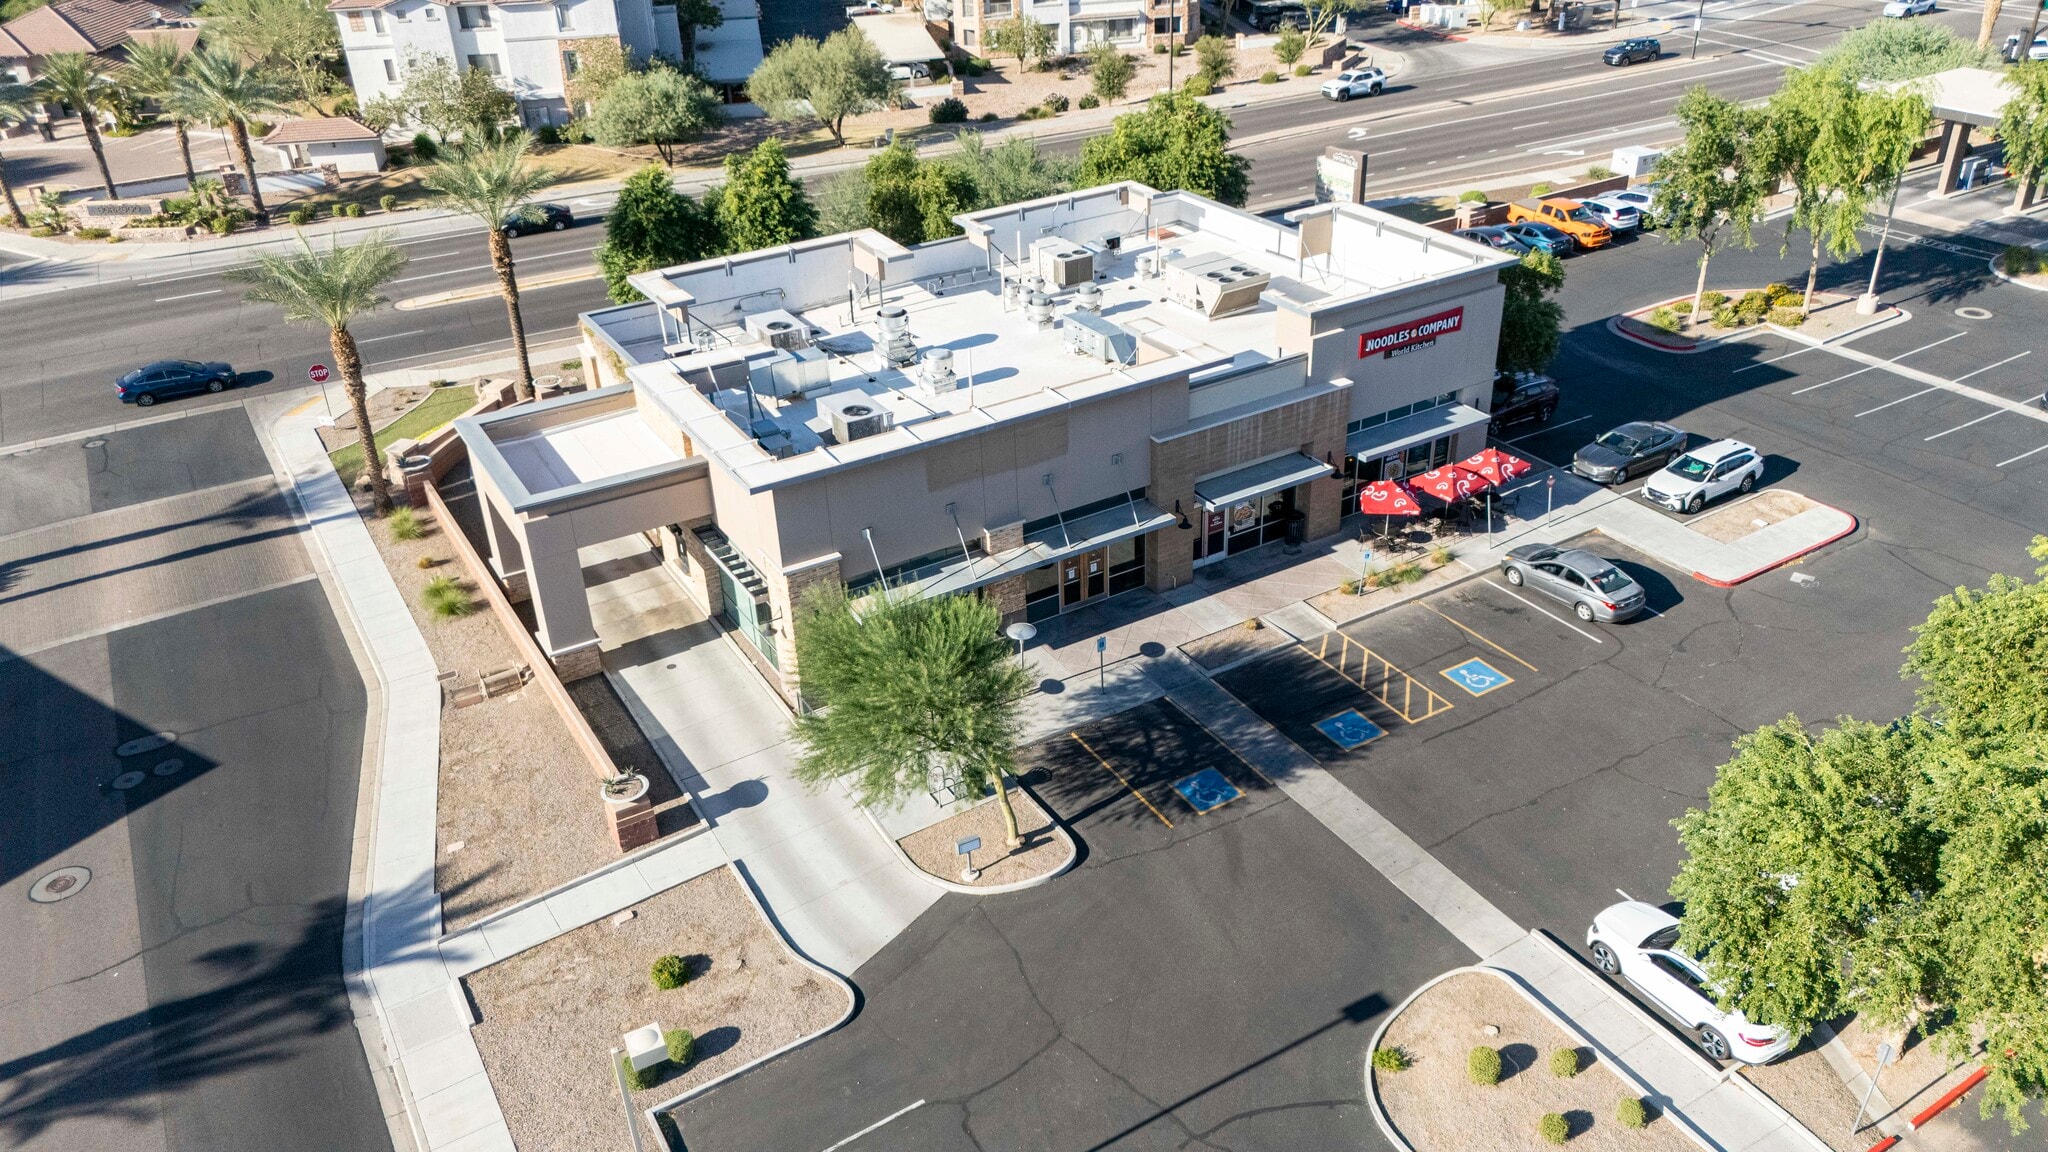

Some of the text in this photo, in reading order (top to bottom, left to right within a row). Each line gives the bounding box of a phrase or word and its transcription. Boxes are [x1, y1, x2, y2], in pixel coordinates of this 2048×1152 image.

[1365, 329, 1410, 352] NOODLES
[1418, 315, 1461, 337] COMPANY
[1391, 340, 1434, 357] World Kitchen
[310, 368, 328, 378] STOP
